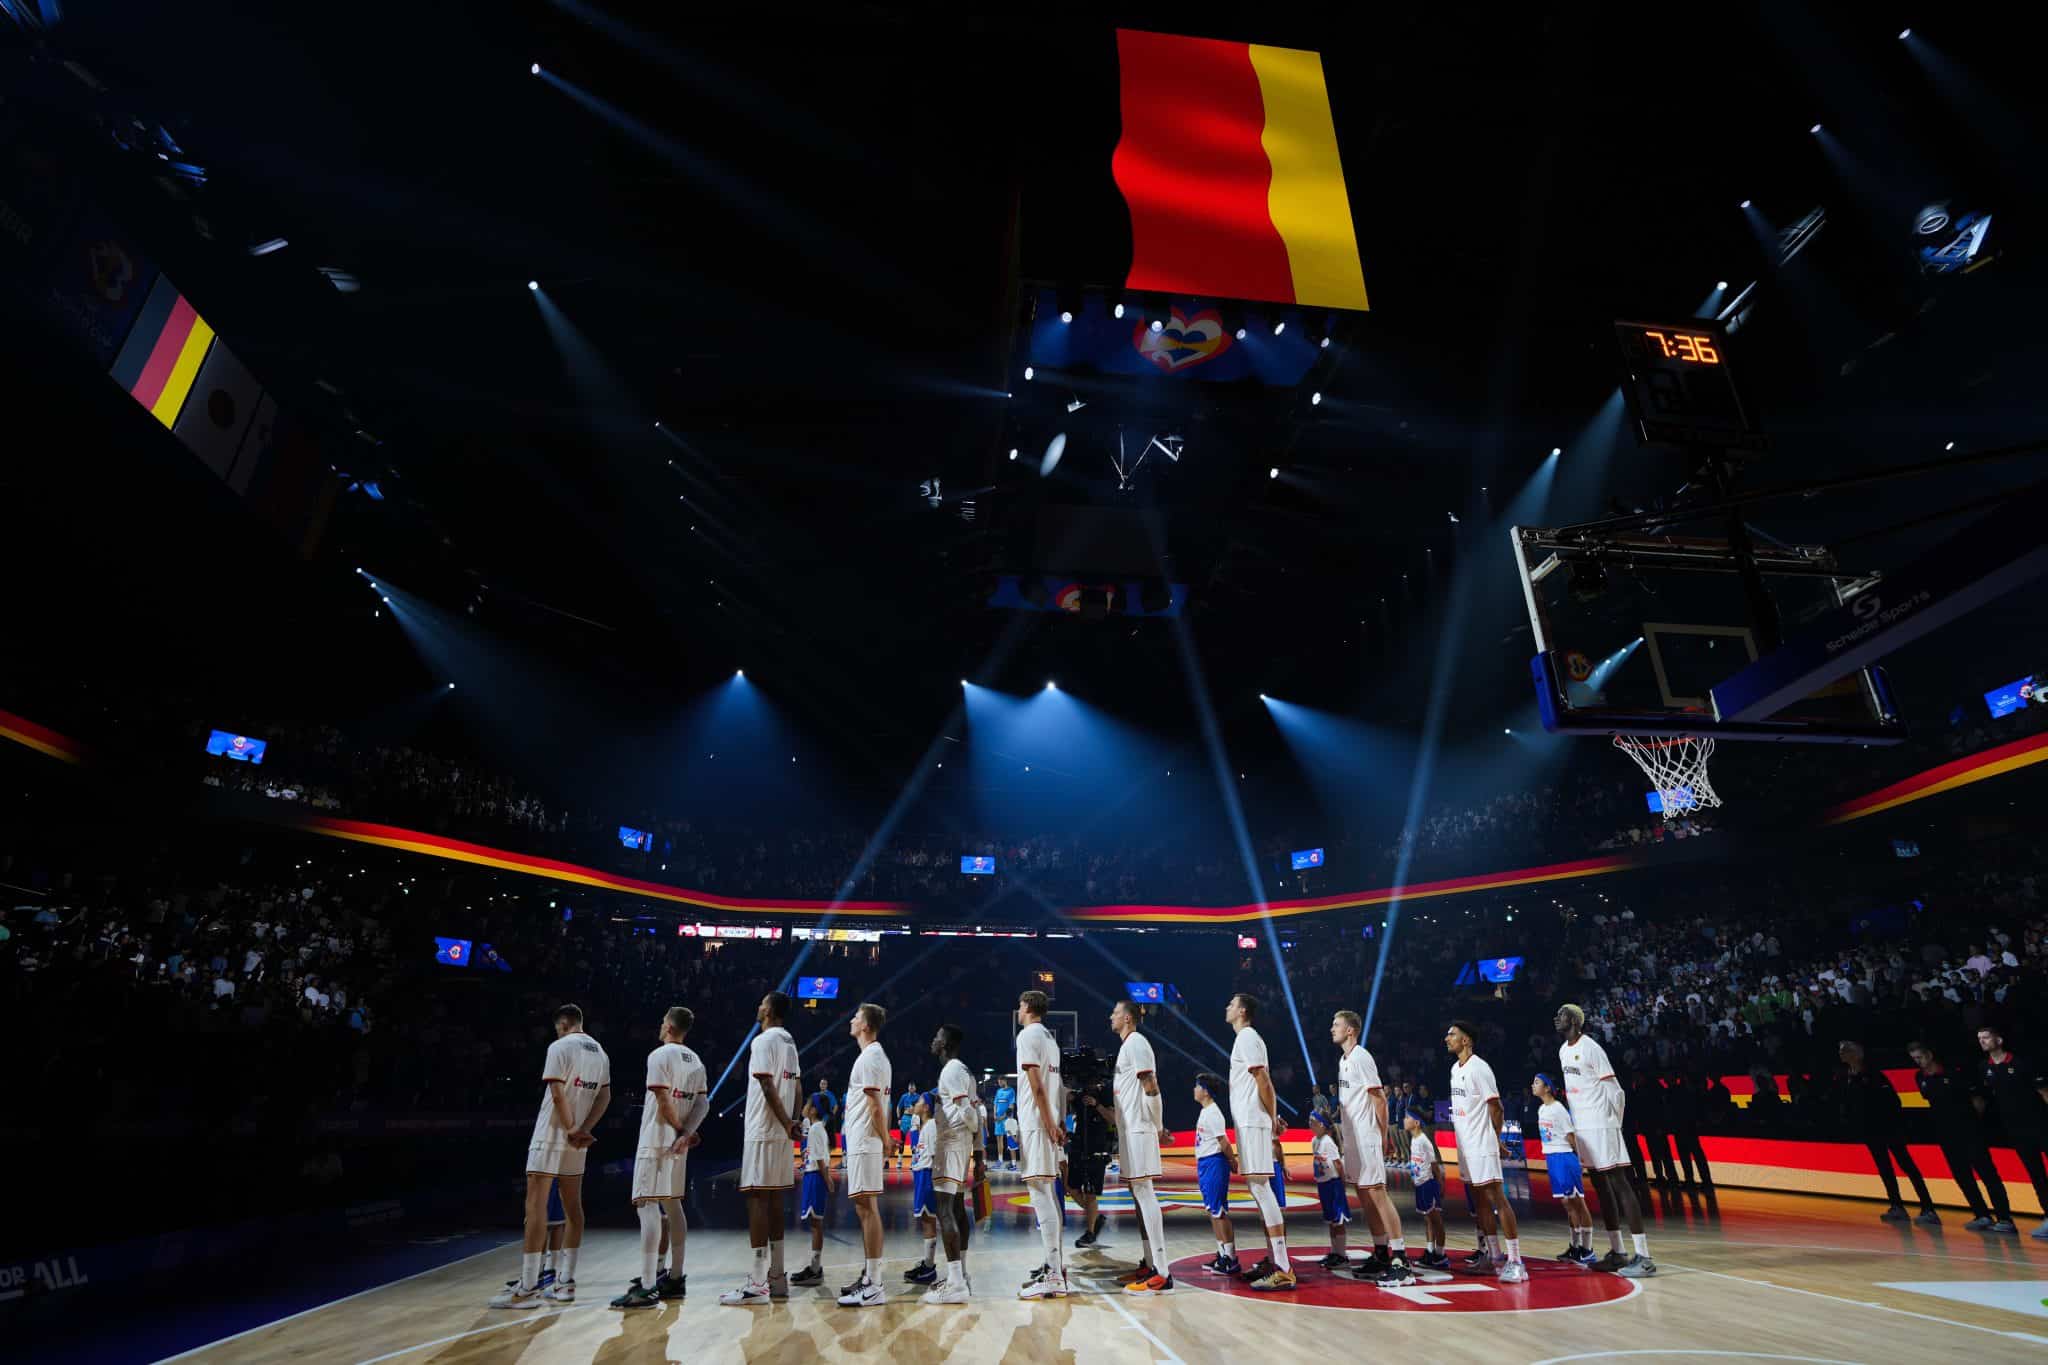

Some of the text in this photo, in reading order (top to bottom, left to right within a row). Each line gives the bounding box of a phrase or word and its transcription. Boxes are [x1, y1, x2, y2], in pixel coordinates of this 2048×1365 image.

[1646, 331, 1719, 364] 7:36
[1879, 590, 1932, 624] Sports
[32, 1255, 89, 1291] ALL
